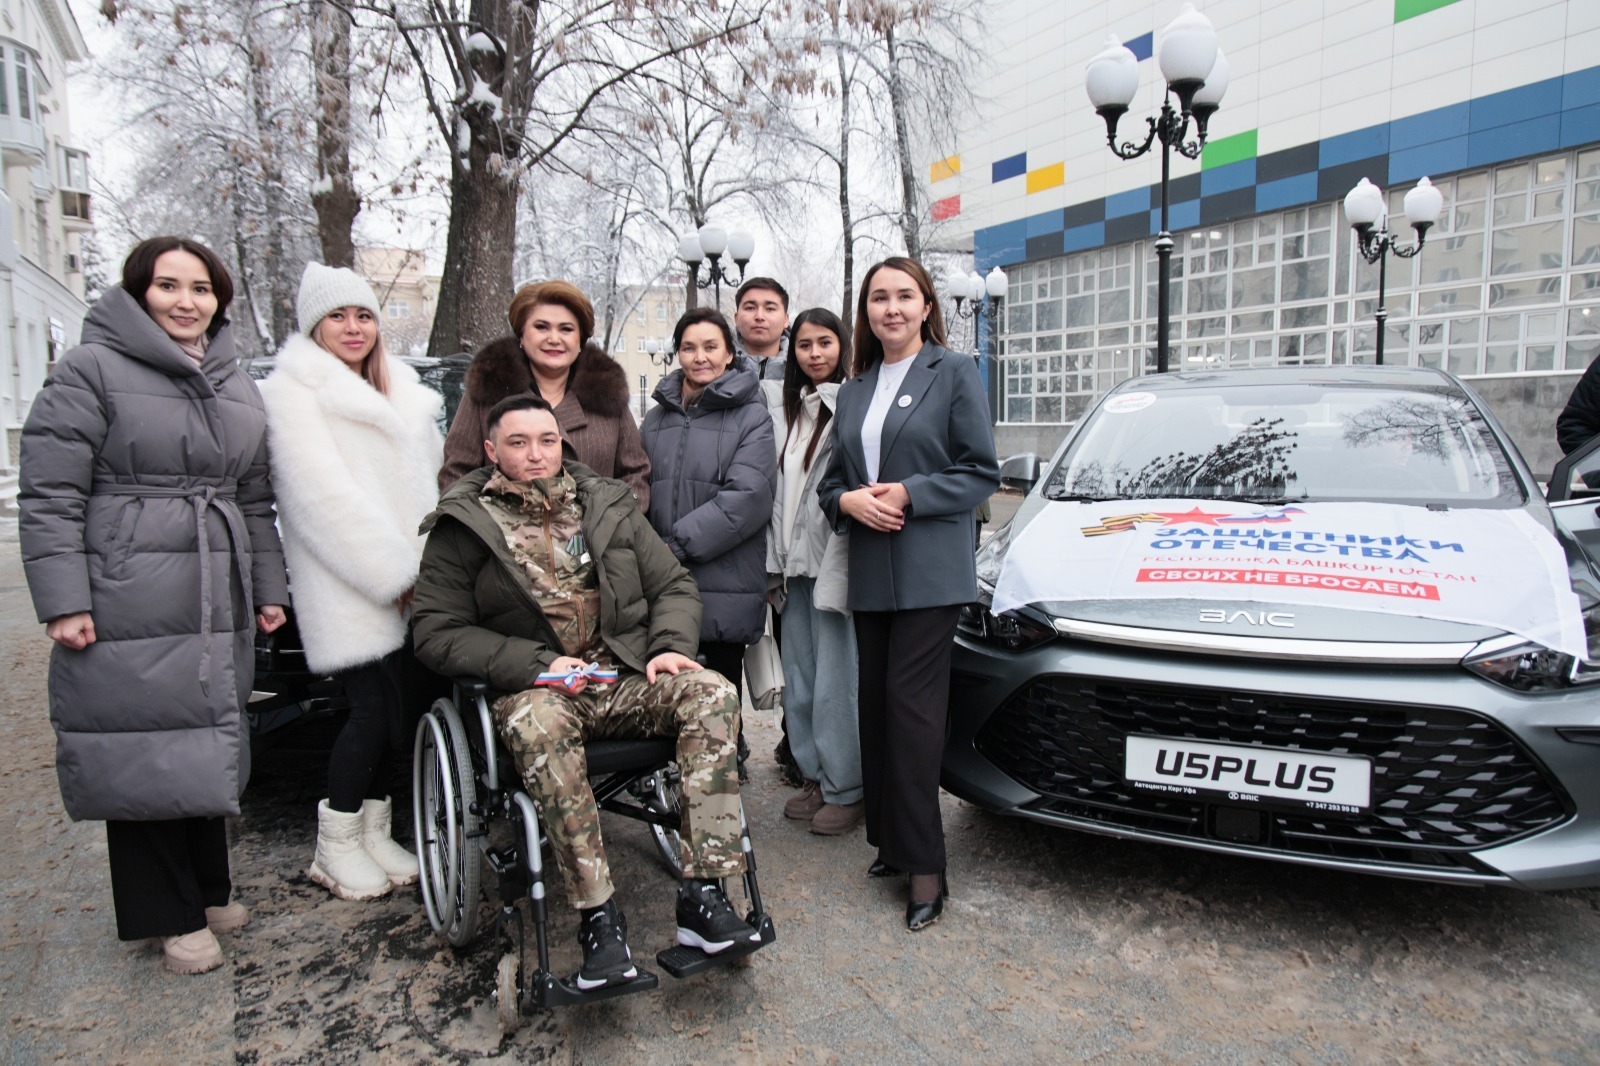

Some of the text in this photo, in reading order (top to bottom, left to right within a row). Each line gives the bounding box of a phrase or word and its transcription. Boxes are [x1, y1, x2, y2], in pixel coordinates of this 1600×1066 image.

[1150, 538, 1430, 563] ОТЕЧЕСТВА
[1154, 528, 1464, 553] ЗАЩИТНИКИ
[1286, 558, 1477, 582] БАШКОРТОСТАН
[1149, 570, 1427, 597] СВОИХ НЕ БРОСАЕМ
[1199, 609, 1295, 628] BAIC
[1155, 749, 1336, 794] U5PLUS
[1134, 781, 1167, 791] Автоцентр
[1240, 793, 1259, 801] BAIC
